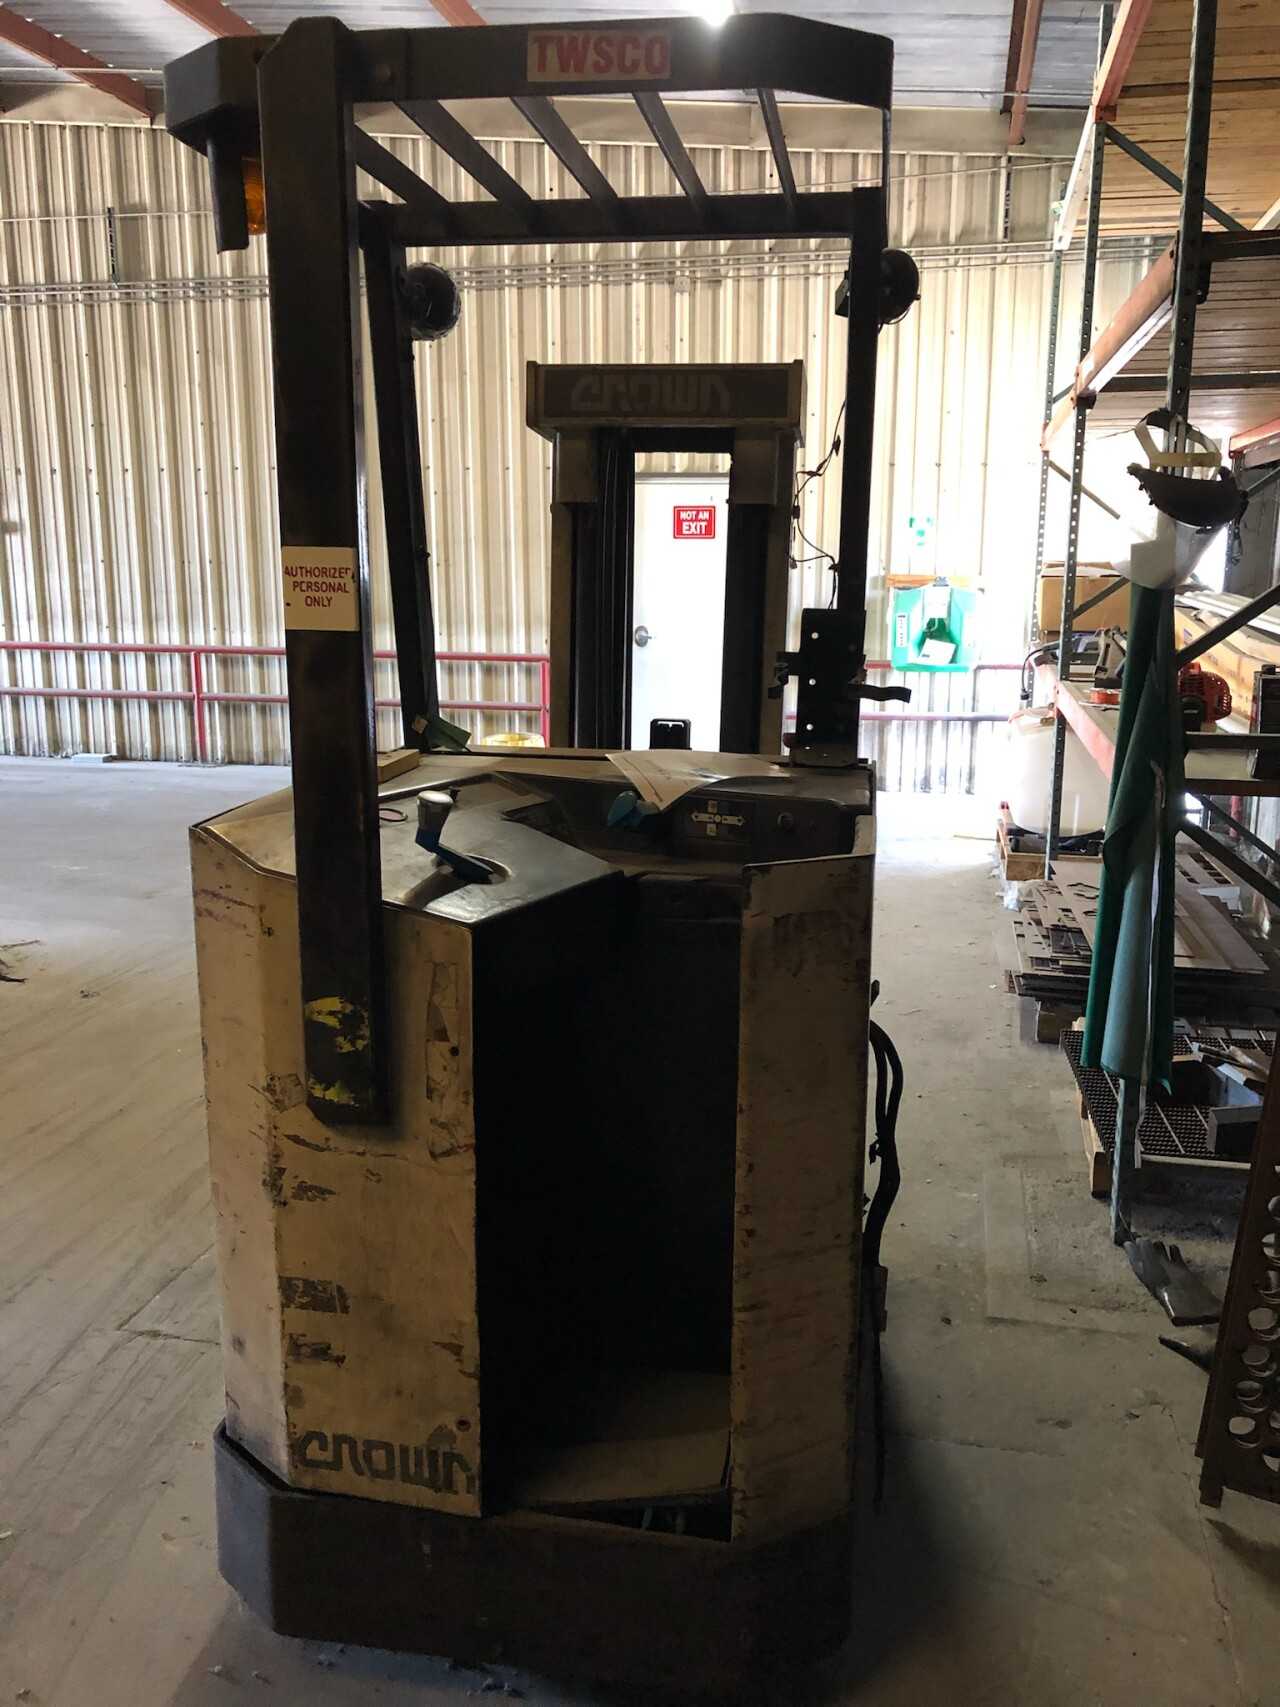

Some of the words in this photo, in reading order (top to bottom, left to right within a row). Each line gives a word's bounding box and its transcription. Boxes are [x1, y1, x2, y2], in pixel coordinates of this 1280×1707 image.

[533, 35, 668, 74] TWSCO
[680, 511, 697, 520] NOT
[698, 511, 709, 520] AN
[682, 521, 707, 534] EXIT
[292, 581, 350, 593] PERSONAL
[305, 596, 333, 608] ONLY
